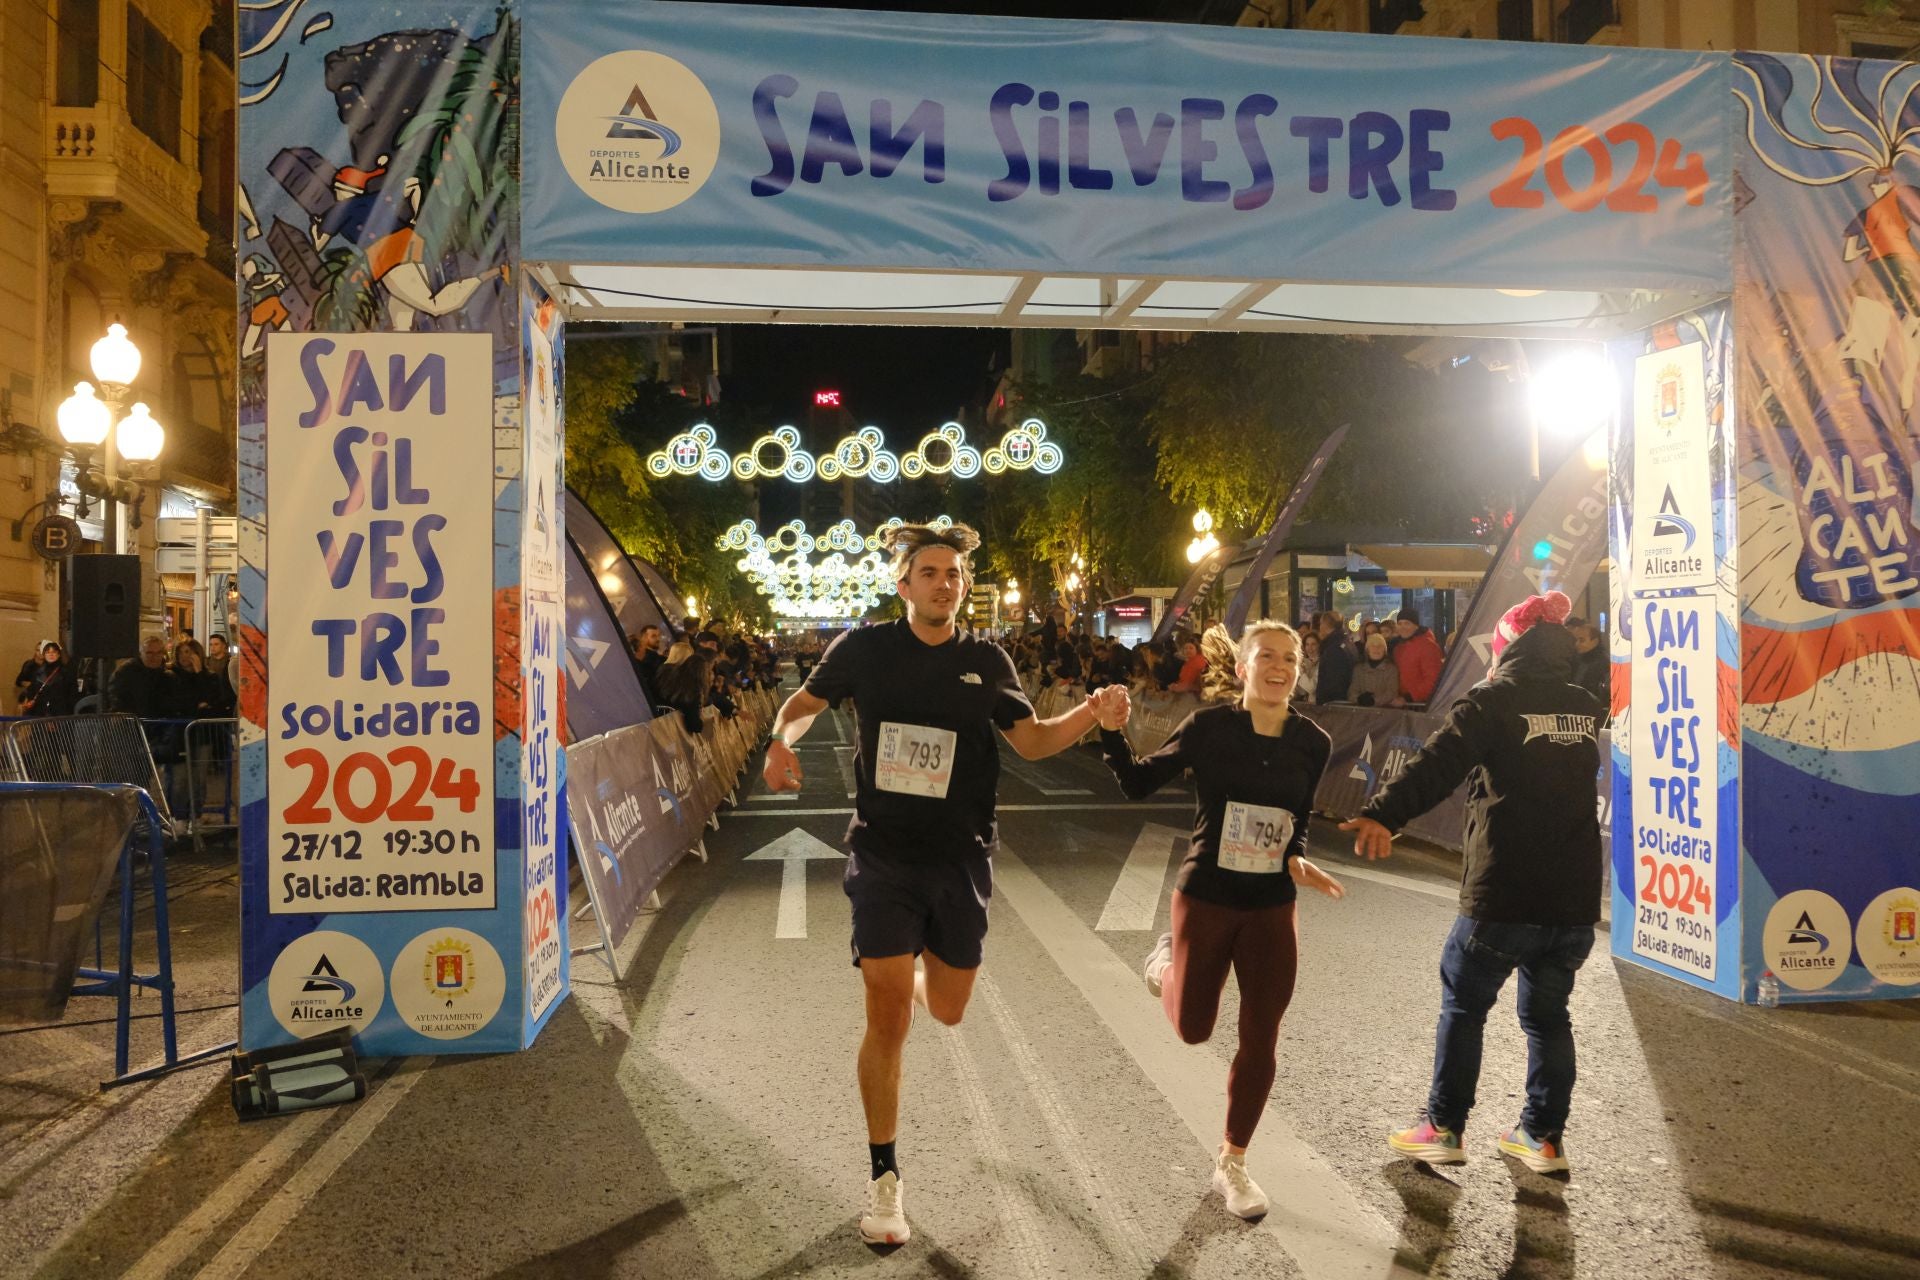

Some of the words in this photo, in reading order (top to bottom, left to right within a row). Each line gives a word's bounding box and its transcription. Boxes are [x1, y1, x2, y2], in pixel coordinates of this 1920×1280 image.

[589, 150, 640, 159] DEPORTES
[751, 73, 946, 197] SAN
[1490, 117, 1709, 213] 2024
[589, 160, 690, 179] Alicante
[299, 338, 446, 428] SAN
[1802, 452, 1898, 505] ALI
[46, 528, 68, 549] B
[1644, 547, 1672, 557] DEPORTES
[1809, 507, 1908, 560] CAN
[316, 513, 448, 604] VES
[1645, 556, 1702, 575] Alicante
[1811, 552, 1918, 602] TE
[1171, 562, 1221, 641] licante
[312, 607, 450, 687] TRE
[1644, 601, 1699, 658] SAN
[529, 726, 549, 790] VES
[909, 741, 941, 770] 793
[1650, 715, 1700, 773] VES
[283, 745, 481, 824] 2024
[1649, 776, 1702, 829] TRE
[528, 791, 549, 848] TRE
[1254, 821, 1283, 848] 794
[281, 830, 362, 862] 27/12
[383, 829, 456, 856] 19:30
[283, 872, 371, 903] Salida:
[376, 870, 484, 899] Rambla
[1640, 855, 1712, 915] 2024
[1640, 905, 1668, 931] 27/12
[1676, 916, 1702, 939] 19:30
[1637, 930, 1670, 955] Salida:
[1671, 942, 1711, 970] Rambla
[1780, 956, 1836, 969] Alicante
[290, 999, 327, 1007] DEPORTES
[291, 1006, 363, 1020] Alicante
[414, 1012, 483, 1022] AYUNTAMIENTO
[421, 1024, 435, 1032] DE
[436, 1023, 478, 1032] ALICANTE
